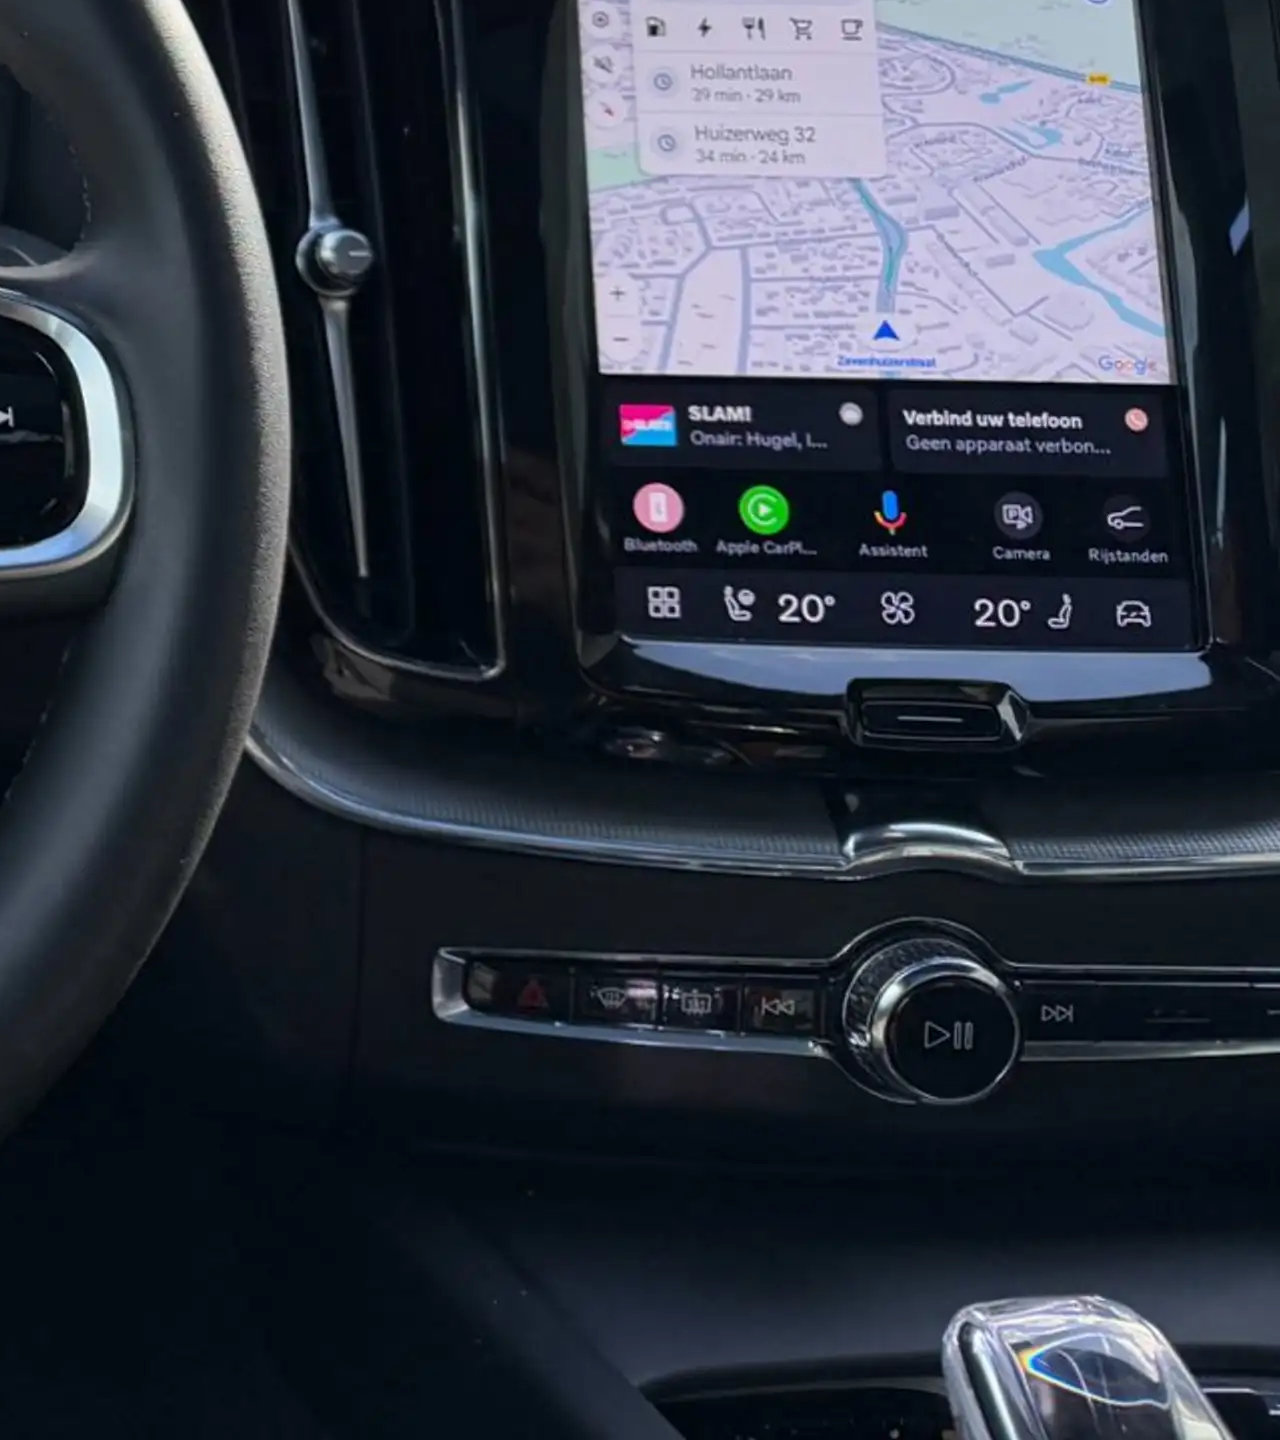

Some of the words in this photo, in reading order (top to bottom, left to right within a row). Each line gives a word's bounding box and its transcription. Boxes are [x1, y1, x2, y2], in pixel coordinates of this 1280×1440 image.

[690, 64, 794, 82] Hollantlaan
[713, 88, 744, 102] min
[754, 88, 775, 103] 29
[778, 89, 801, 103] km
[694, 124, 790, 146] Huizerweg
[793, 126, 817, 143] 32
[719, 148, 747, 164] min
[758, 150, 778, 165] 24
[782, 150, 806, 165] km
[1098, 355, 1158, 375] Google
[688, 405, 753, 423] SLAM!
[902, 408, 973, 427] Verbind
[975, 414, 1004, 428] uw
[1008, 410, 1084, 429] telefoon
[689, 429, 742, 447] Onair:
[745, 431, 804, 452] Hugel,
[905, 434, 952, 451] Geen
[955, 437, 1032, 456] apparaat
[1034, 436, 1112, 455] verbon...
[623, 537, 699, 553] Bluetooth
[715, 539, 760, 558] Apple
[858, 543, 929, 559] Assistent
[991, 545, 1052, 561] Camera
[1088, 548, 1169, 565] Rijstanden
[777, 593, 836, 624] 20°
[973, 598, 1032, 628] 20°
